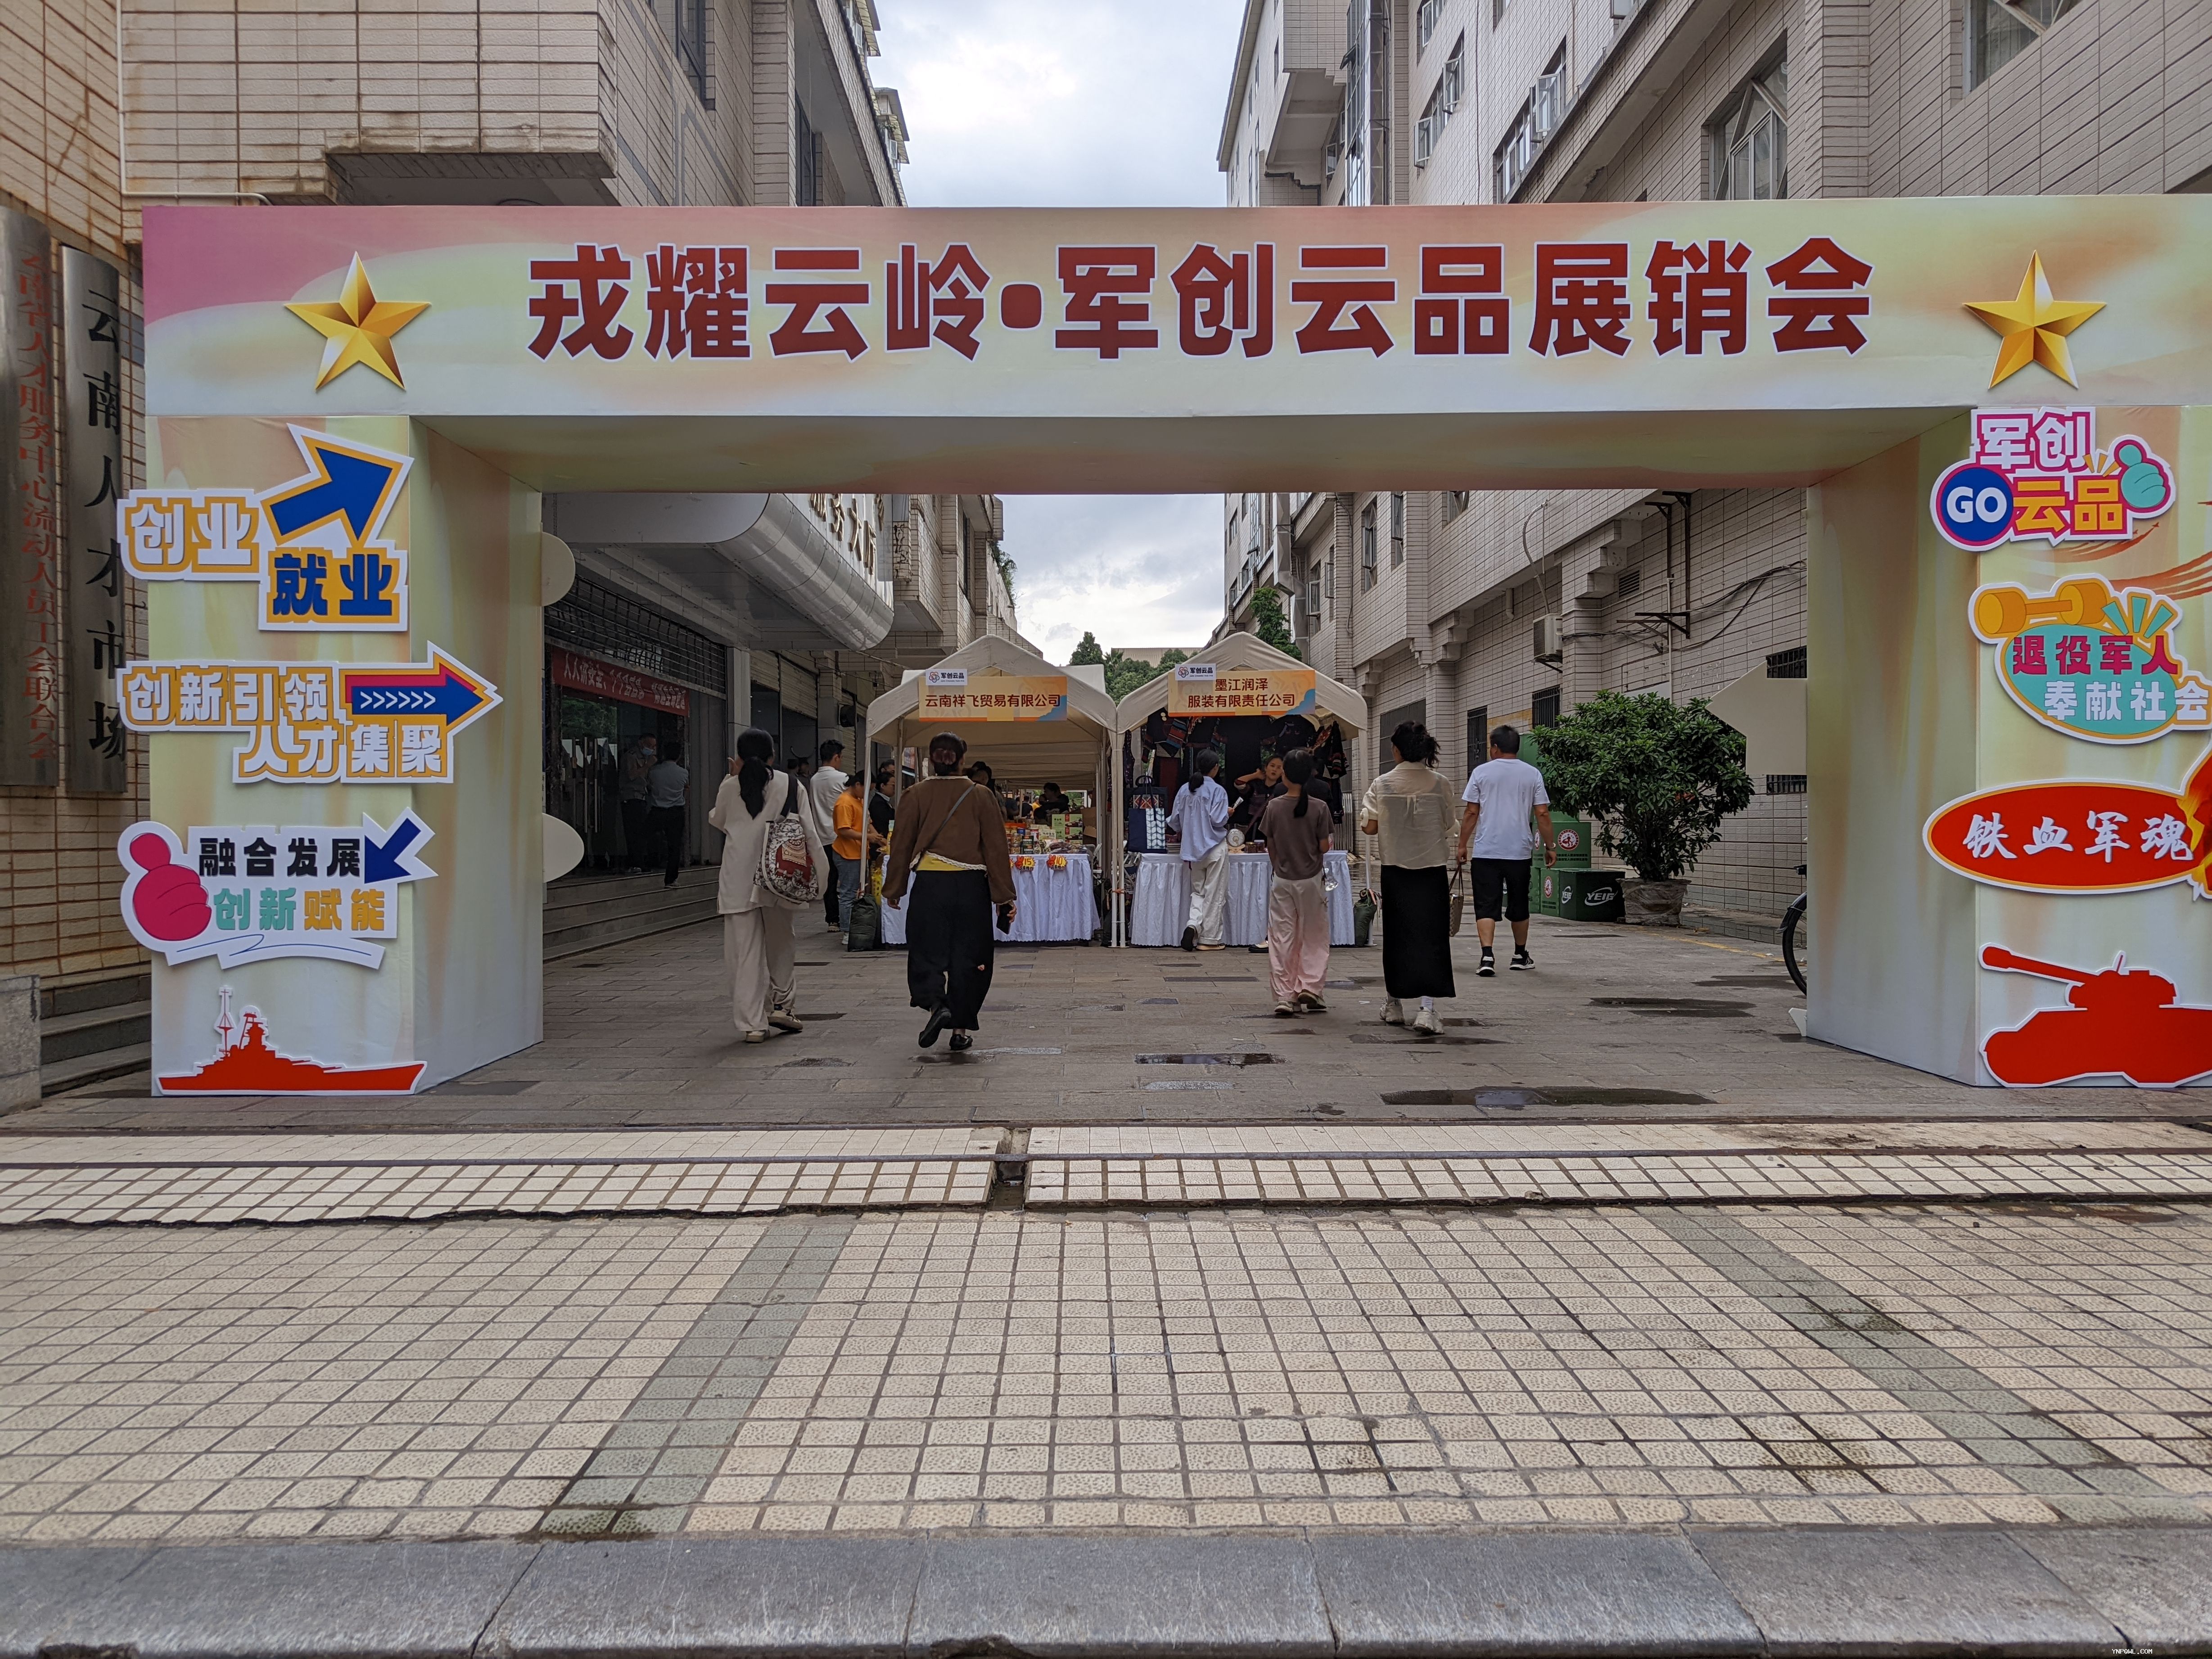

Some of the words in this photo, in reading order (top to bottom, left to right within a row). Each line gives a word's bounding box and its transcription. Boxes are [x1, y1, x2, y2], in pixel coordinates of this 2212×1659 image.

[1980, 416, 2088, 471] 军创
[1946, 486, 2007, 523] GO
[2013, 479, 2123, 532] 云品
[130, 503, 252, 565] 创业
[273, 553, 393, 616] 就业
[2013, 635, 2178, 675] 退役军人
[126, 672, 333, 722] 创新引领
[925, 694, 1061, 708] 云南祥飞贸易有限公司
[1187, 694, 1295, 708] 服装有限责任公司
[1215, 678, 1268, 691] 墨江润泽
[2044, 679, 2209, 721] 奉献社会
[244, 723, 442, 773] 人才集聚
[199, 837, 360, 877] 融合发展
[1962, 810, 2194, 863] 铁血军魂
[1056, 856, 1063, 865] 10
[213, 887, 385, 931] 创新赋能
[1562, 891, 1571, 900] YEIG
[1587, 893, 1616, 901] YEIG
